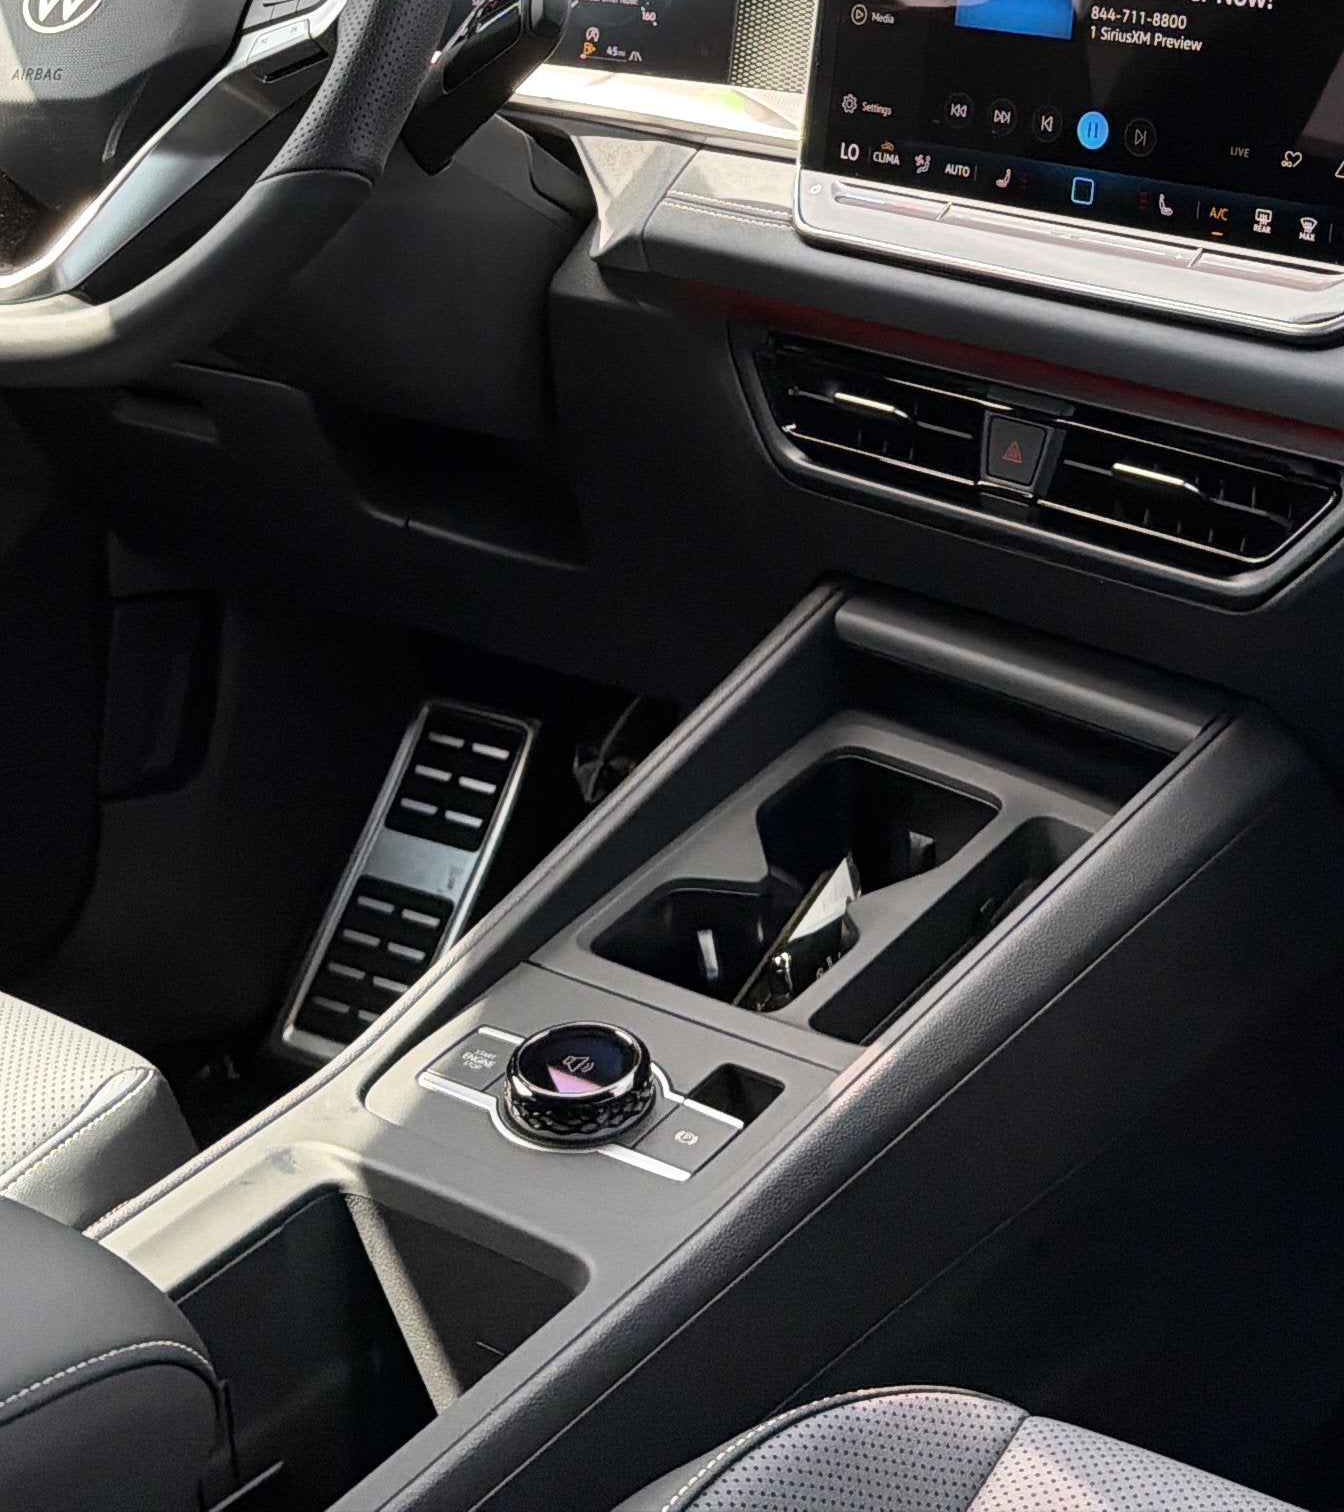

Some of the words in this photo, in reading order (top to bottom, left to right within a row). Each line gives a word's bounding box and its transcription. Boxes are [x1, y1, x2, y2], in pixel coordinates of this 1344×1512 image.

[642, 11, 656, 21] 160
[871, 12, 895, 24] Media
[1090, 5, 1188, 29] 844-711-8800
[1100, 26, 1151, 46] SiriusXM
[1154, 33, 1203, 52] Preview
[607, 46, 618, 56] 45
[11, 67, 64, 82] AIRBAG
[861, 101, 893, 117] Settings
[840, 142, 860, 161] LO
[872, 151, 901, 166] CLIMA
[1230, 146, 1250, 159] LIVE
[944, 163, 970, 178] AUTO
[1209, 206, 1229, 221] A/C
[1253, 223, 1272, 234] REAR
[1299, 231, 1316, 243] MAX
